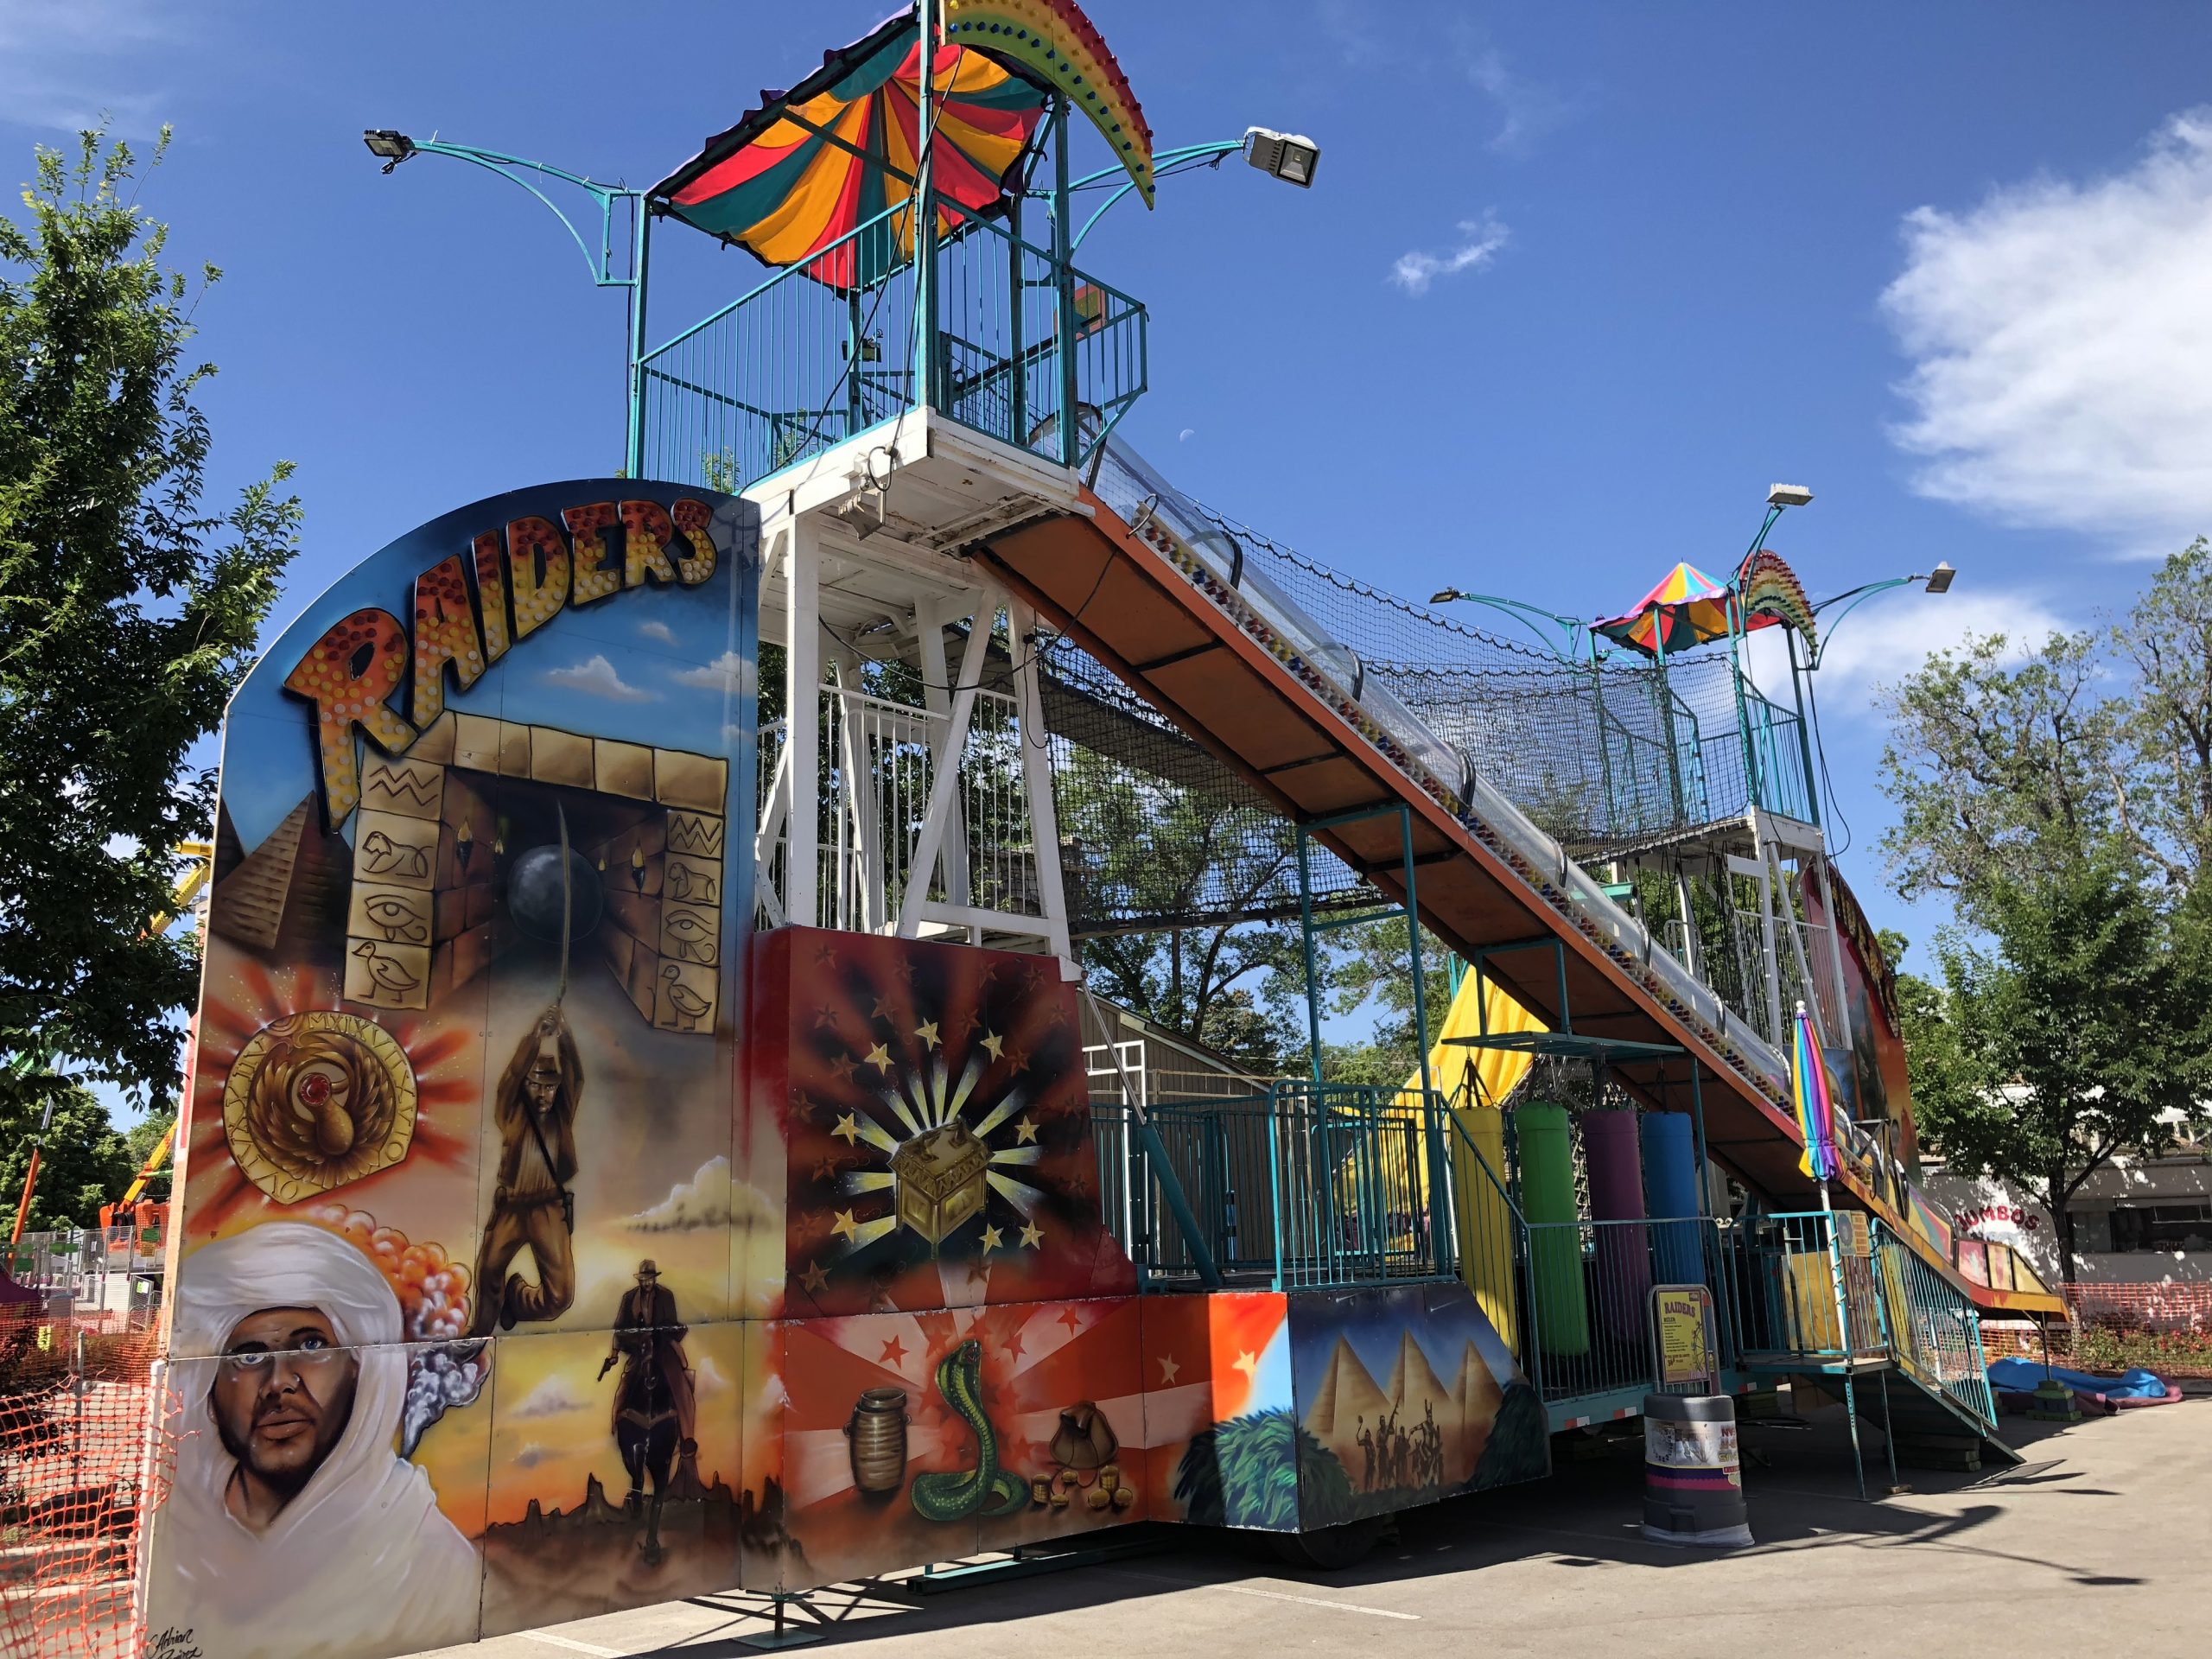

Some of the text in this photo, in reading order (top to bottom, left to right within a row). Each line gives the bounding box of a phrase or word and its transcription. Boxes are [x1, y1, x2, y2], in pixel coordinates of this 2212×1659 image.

[283, 498, 718, 834] RAIDERS
[1955, 1205, 2040, 1232] JUMBOS
[1664, 1301, 1696, 1318] RAIDERS
